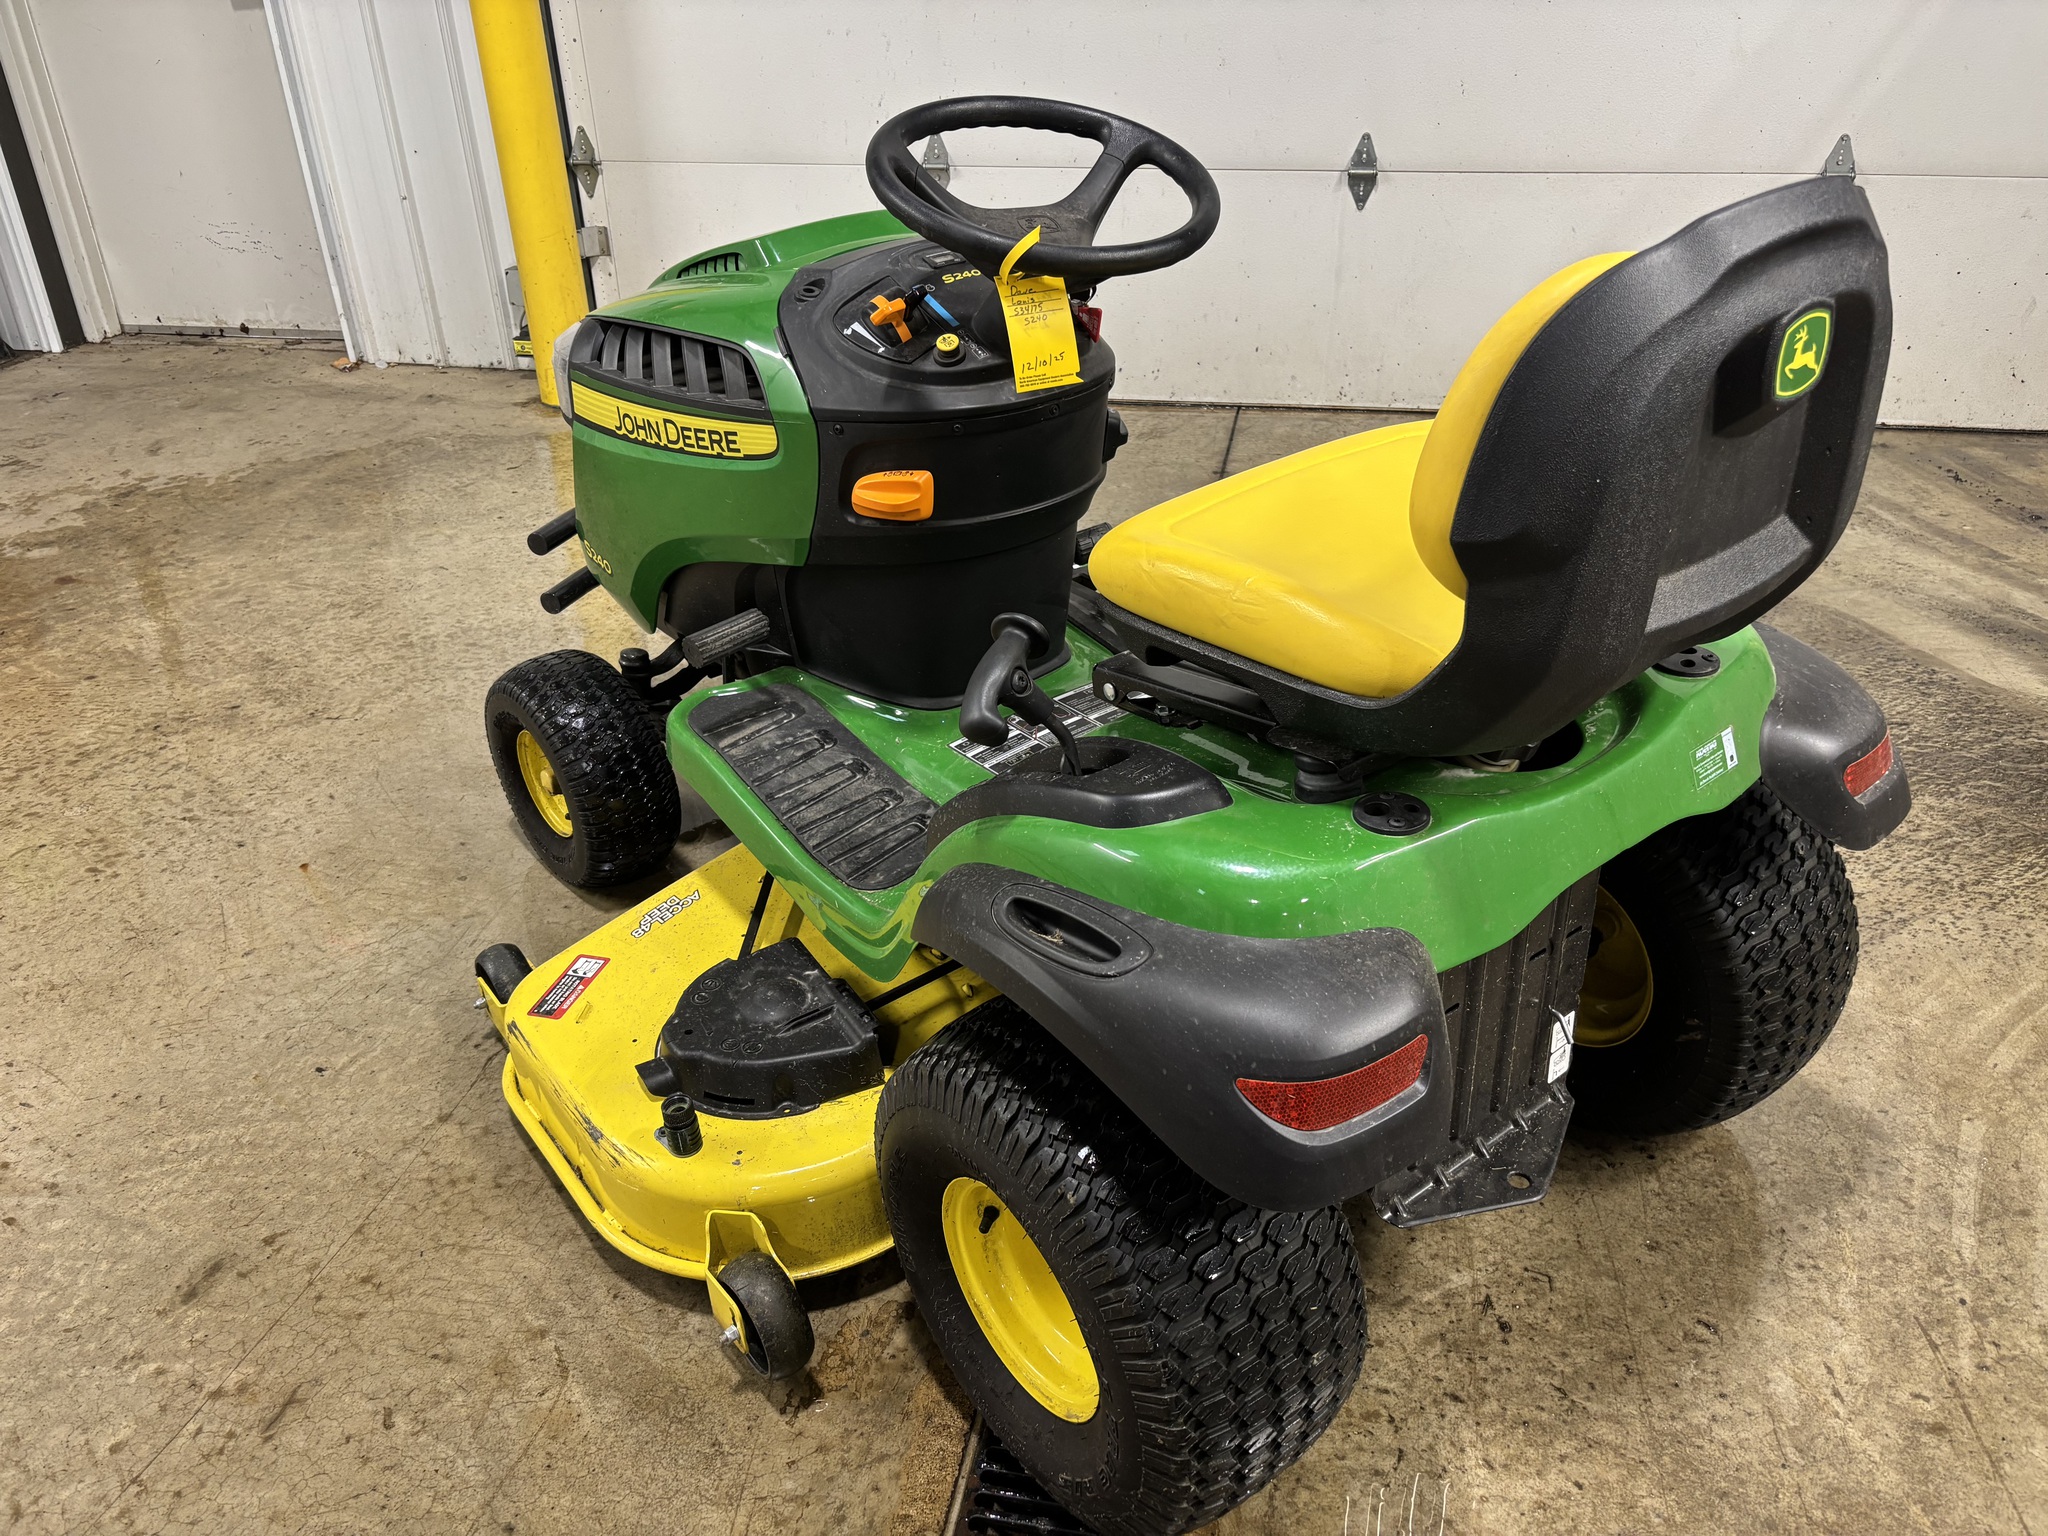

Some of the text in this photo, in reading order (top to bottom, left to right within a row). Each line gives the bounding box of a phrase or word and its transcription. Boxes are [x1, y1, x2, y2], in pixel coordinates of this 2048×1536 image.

[942, 269, 982, 284] S240
[615, 406, 742, 454] JOHN DEERE
[583, 539, 612, 576] S240
[639, 894, 681, 928] DEEP
[650, 889, 701, 925] ACCEL
[561, 988, 583, 1010] DANGER
